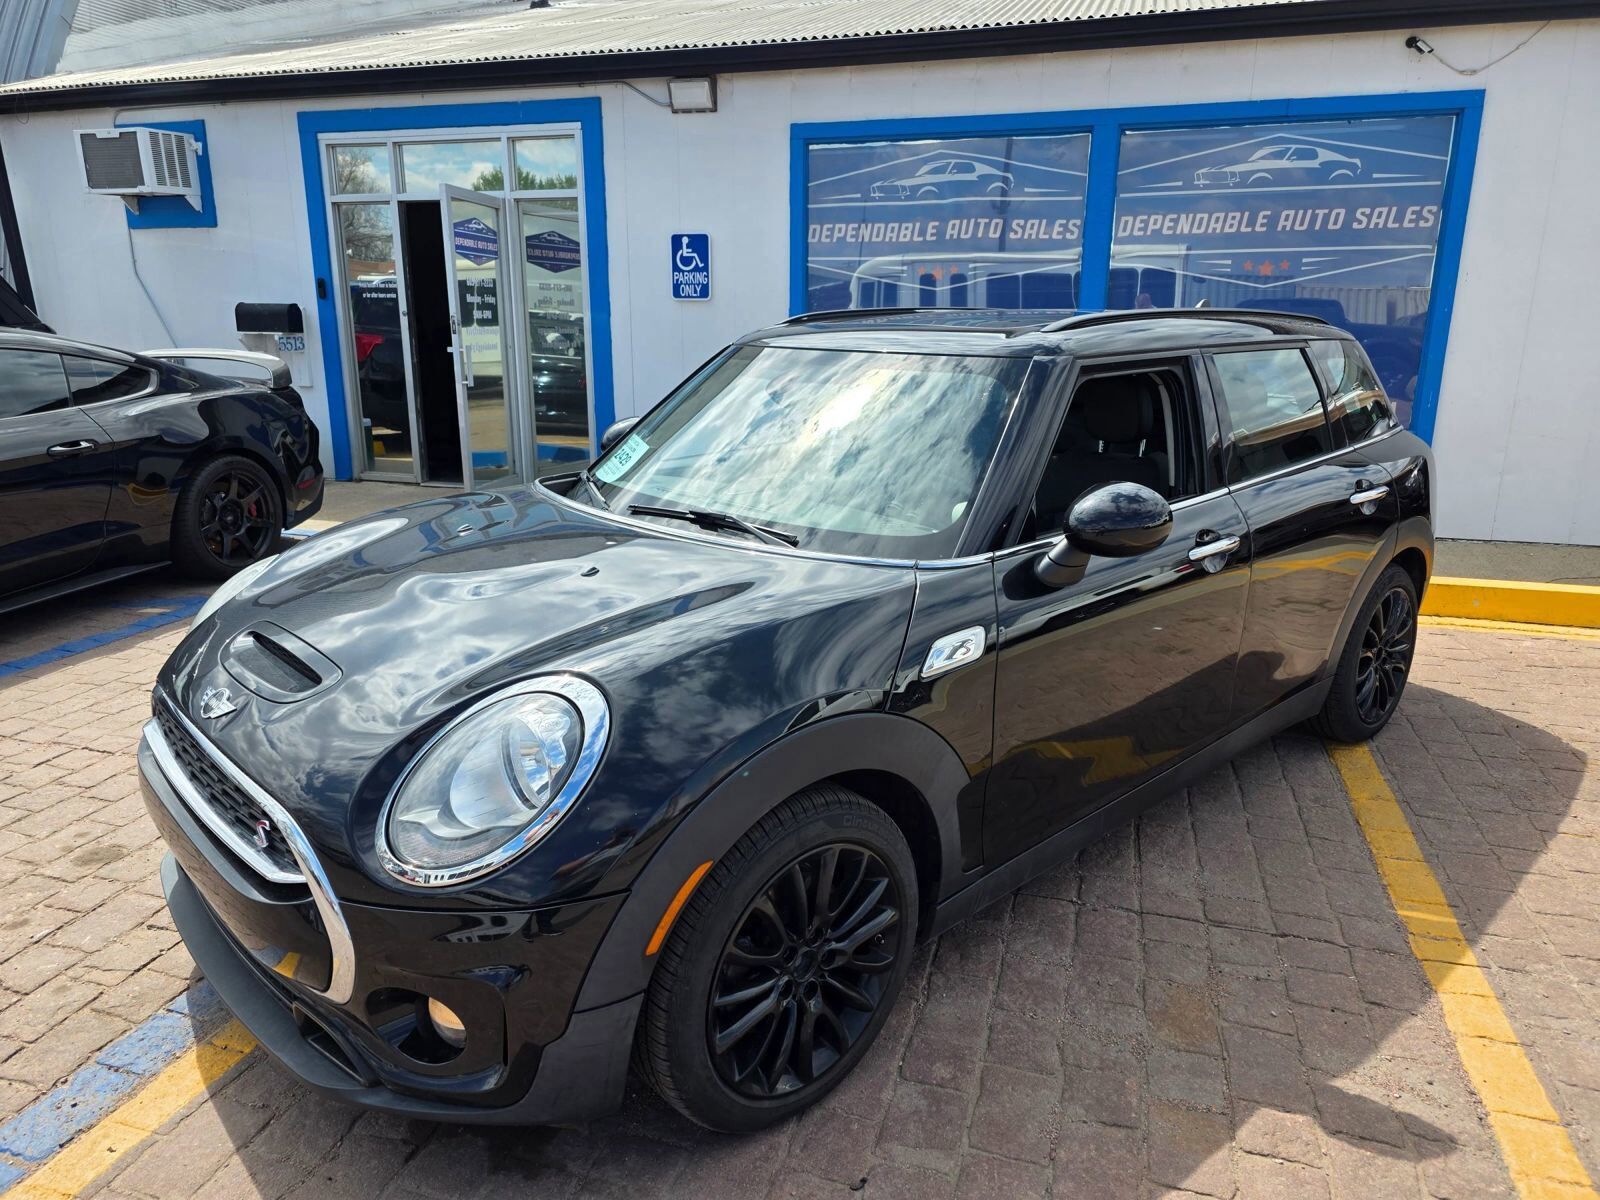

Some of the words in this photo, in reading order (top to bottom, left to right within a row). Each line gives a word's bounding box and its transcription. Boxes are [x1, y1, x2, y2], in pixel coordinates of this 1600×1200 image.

[1117, 210, 1271, 237] DEPENDABLE
[1277, 208, 1347, 232] AUTO
[1352, 205, 1438, 230] SALES
[807, 221, 939, 244] DEPENDABLE
[945, 218, 1002, 240] AUTO
[1009, 218, 1082, 240] SALES
[673, 271, 708, 285] PARKING
[680, 284, 702, 297] ONLY
[466, 293, 482, 305] Monday
[484, 293, 496, 306] Friday
[278, 336, 305, 352] 5513
